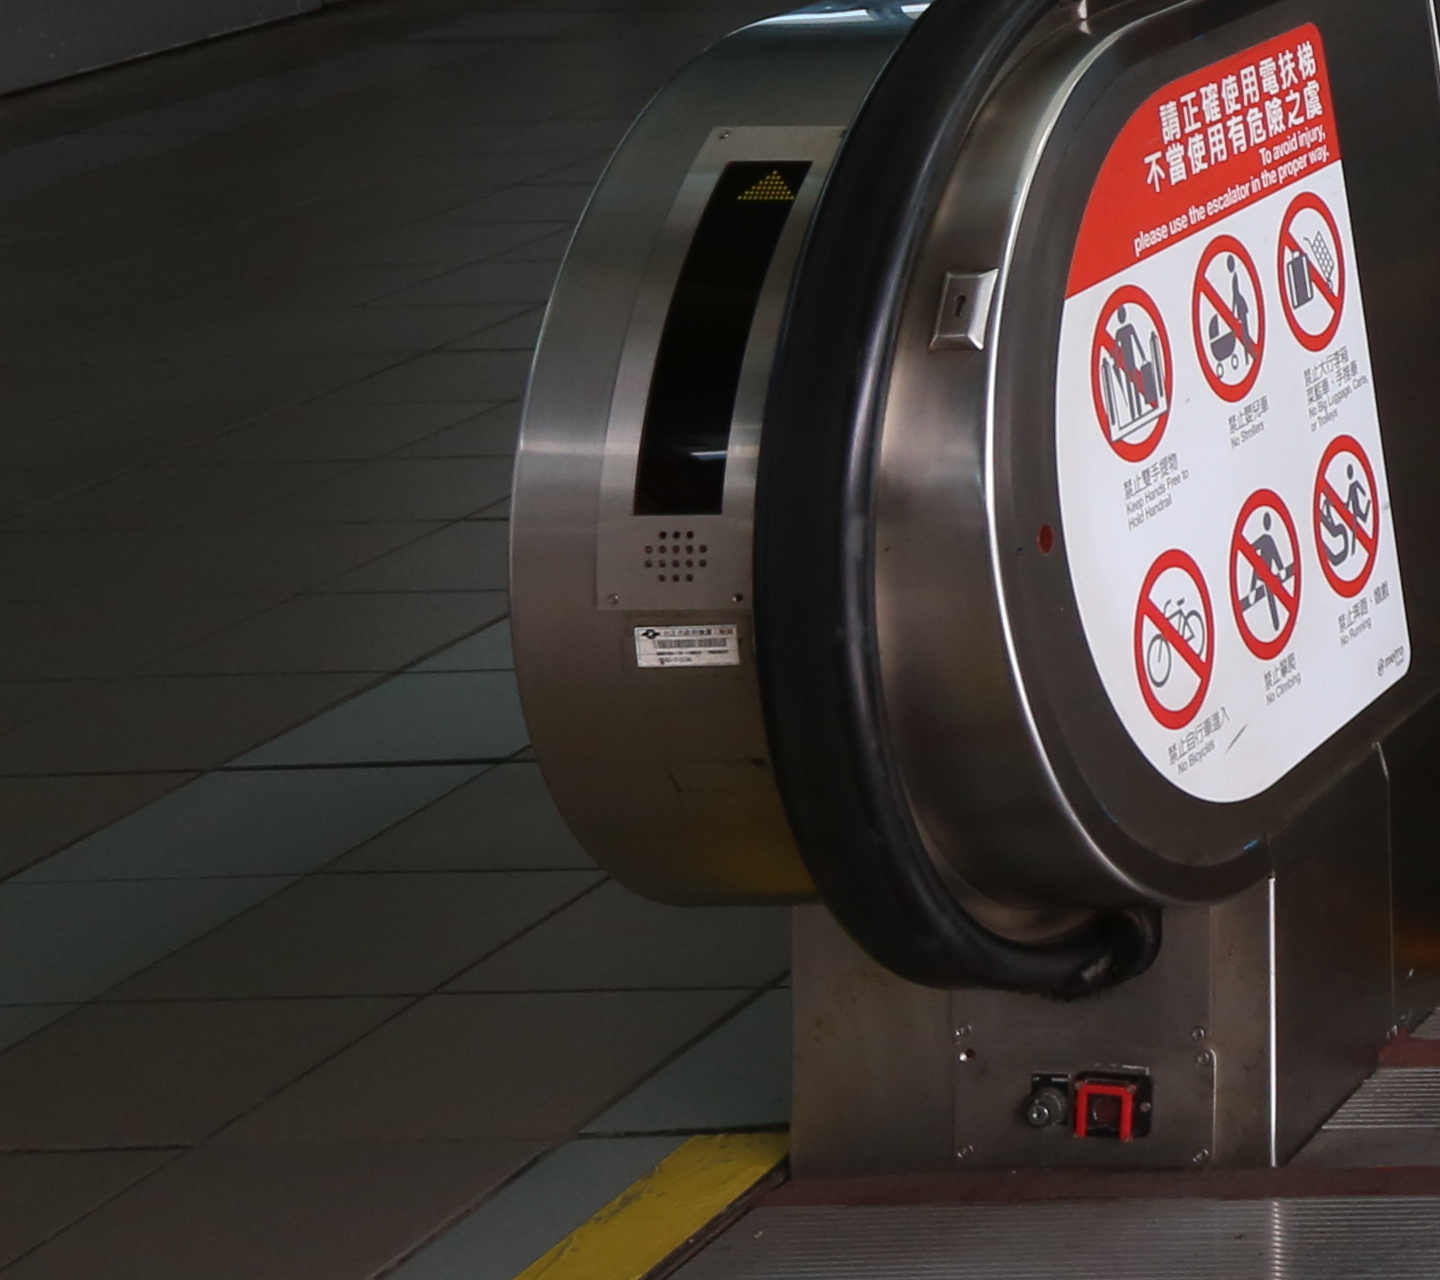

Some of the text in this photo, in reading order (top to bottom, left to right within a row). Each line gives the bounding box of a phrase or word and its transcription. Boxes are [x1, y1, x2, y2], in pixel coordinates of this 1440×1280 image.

[1159, 40, 1317, 145] 請正確使用電扶梯
[1143, 80, 1324, 193] 不當使用有危險之虞
[1258, 124, 1326, 166] To avoid injury,
[1133, 145, 1330, 257] please use the escalator in the proper way.
[1230, 434, 1242, 450] No
[1125, 493, 1145, 518] Keep
[1145, 480, 1167, 508] Hands
[1166, 473, 1182, 495] Free
[1128, 492, 1172, 531] Hold Handrail
